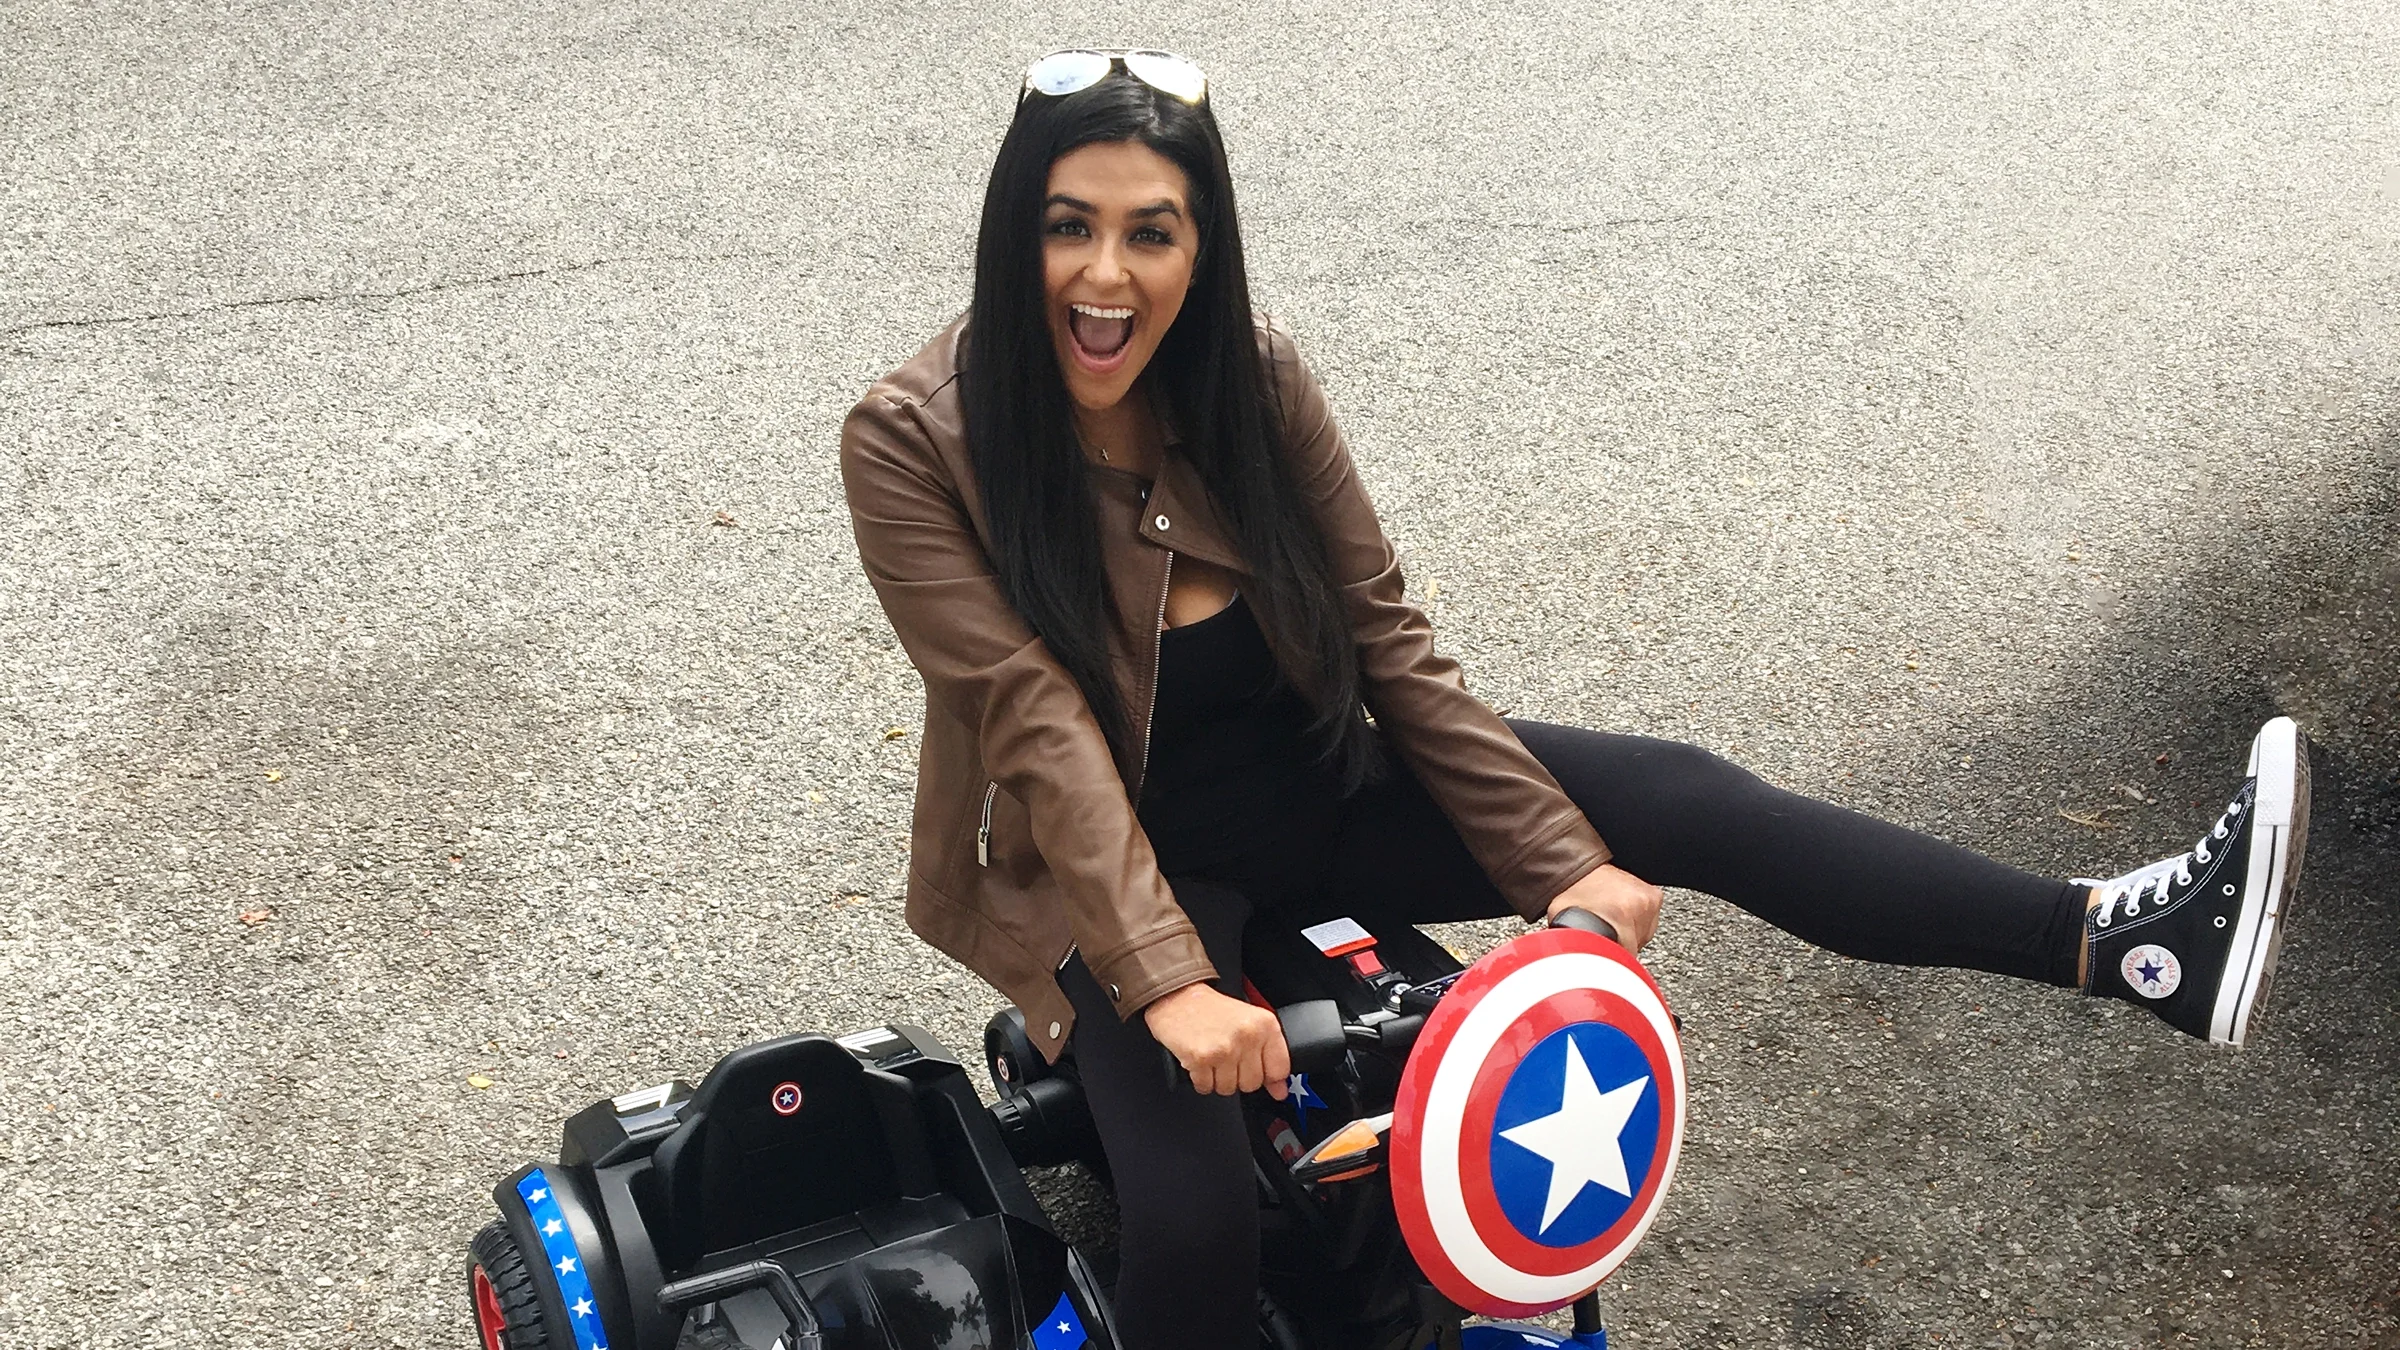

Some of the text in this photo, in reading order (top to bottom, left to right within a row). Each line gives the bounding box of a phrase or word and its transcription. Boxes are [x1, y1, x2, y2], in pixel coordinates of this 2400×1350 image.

[2126, 950, 2146, 988] CONVERSE
[2160, 957, 2176, 993] ALL STAR
